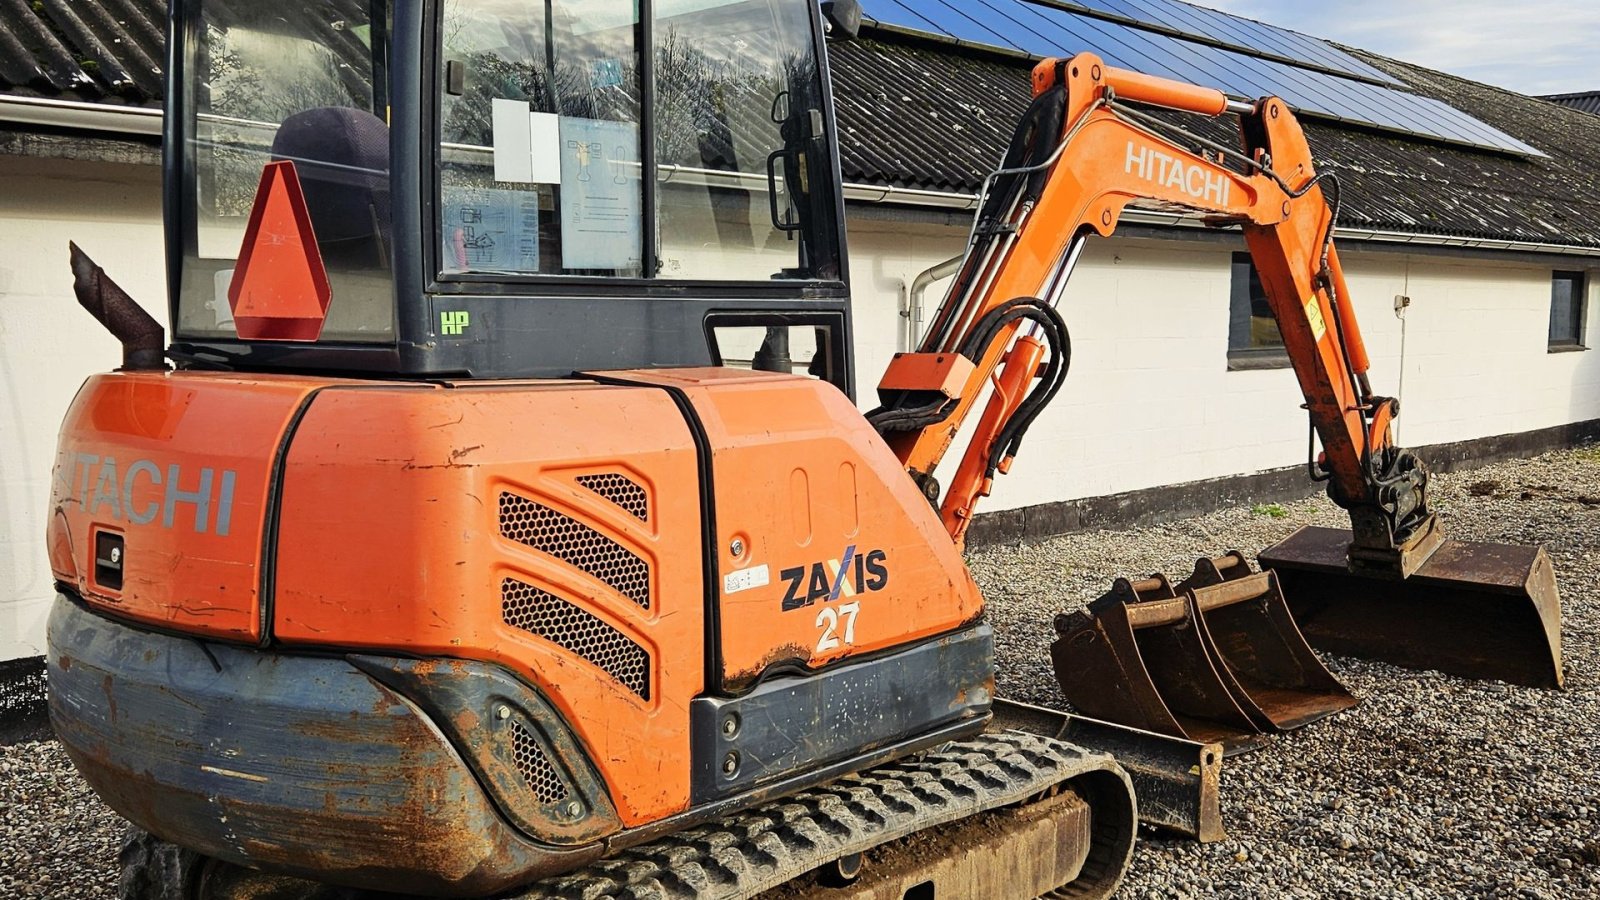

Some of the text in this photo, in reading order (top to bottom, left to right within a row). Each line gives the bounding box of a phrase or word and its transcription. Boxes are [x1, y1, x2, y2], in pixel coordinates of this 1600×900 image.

[1125, 141, 1231, 209] HITACHI
[440, 311, 469, 335] HP
[780, 544, 888, 612] ZAXIS
[815, 600, 860, 653] 27
